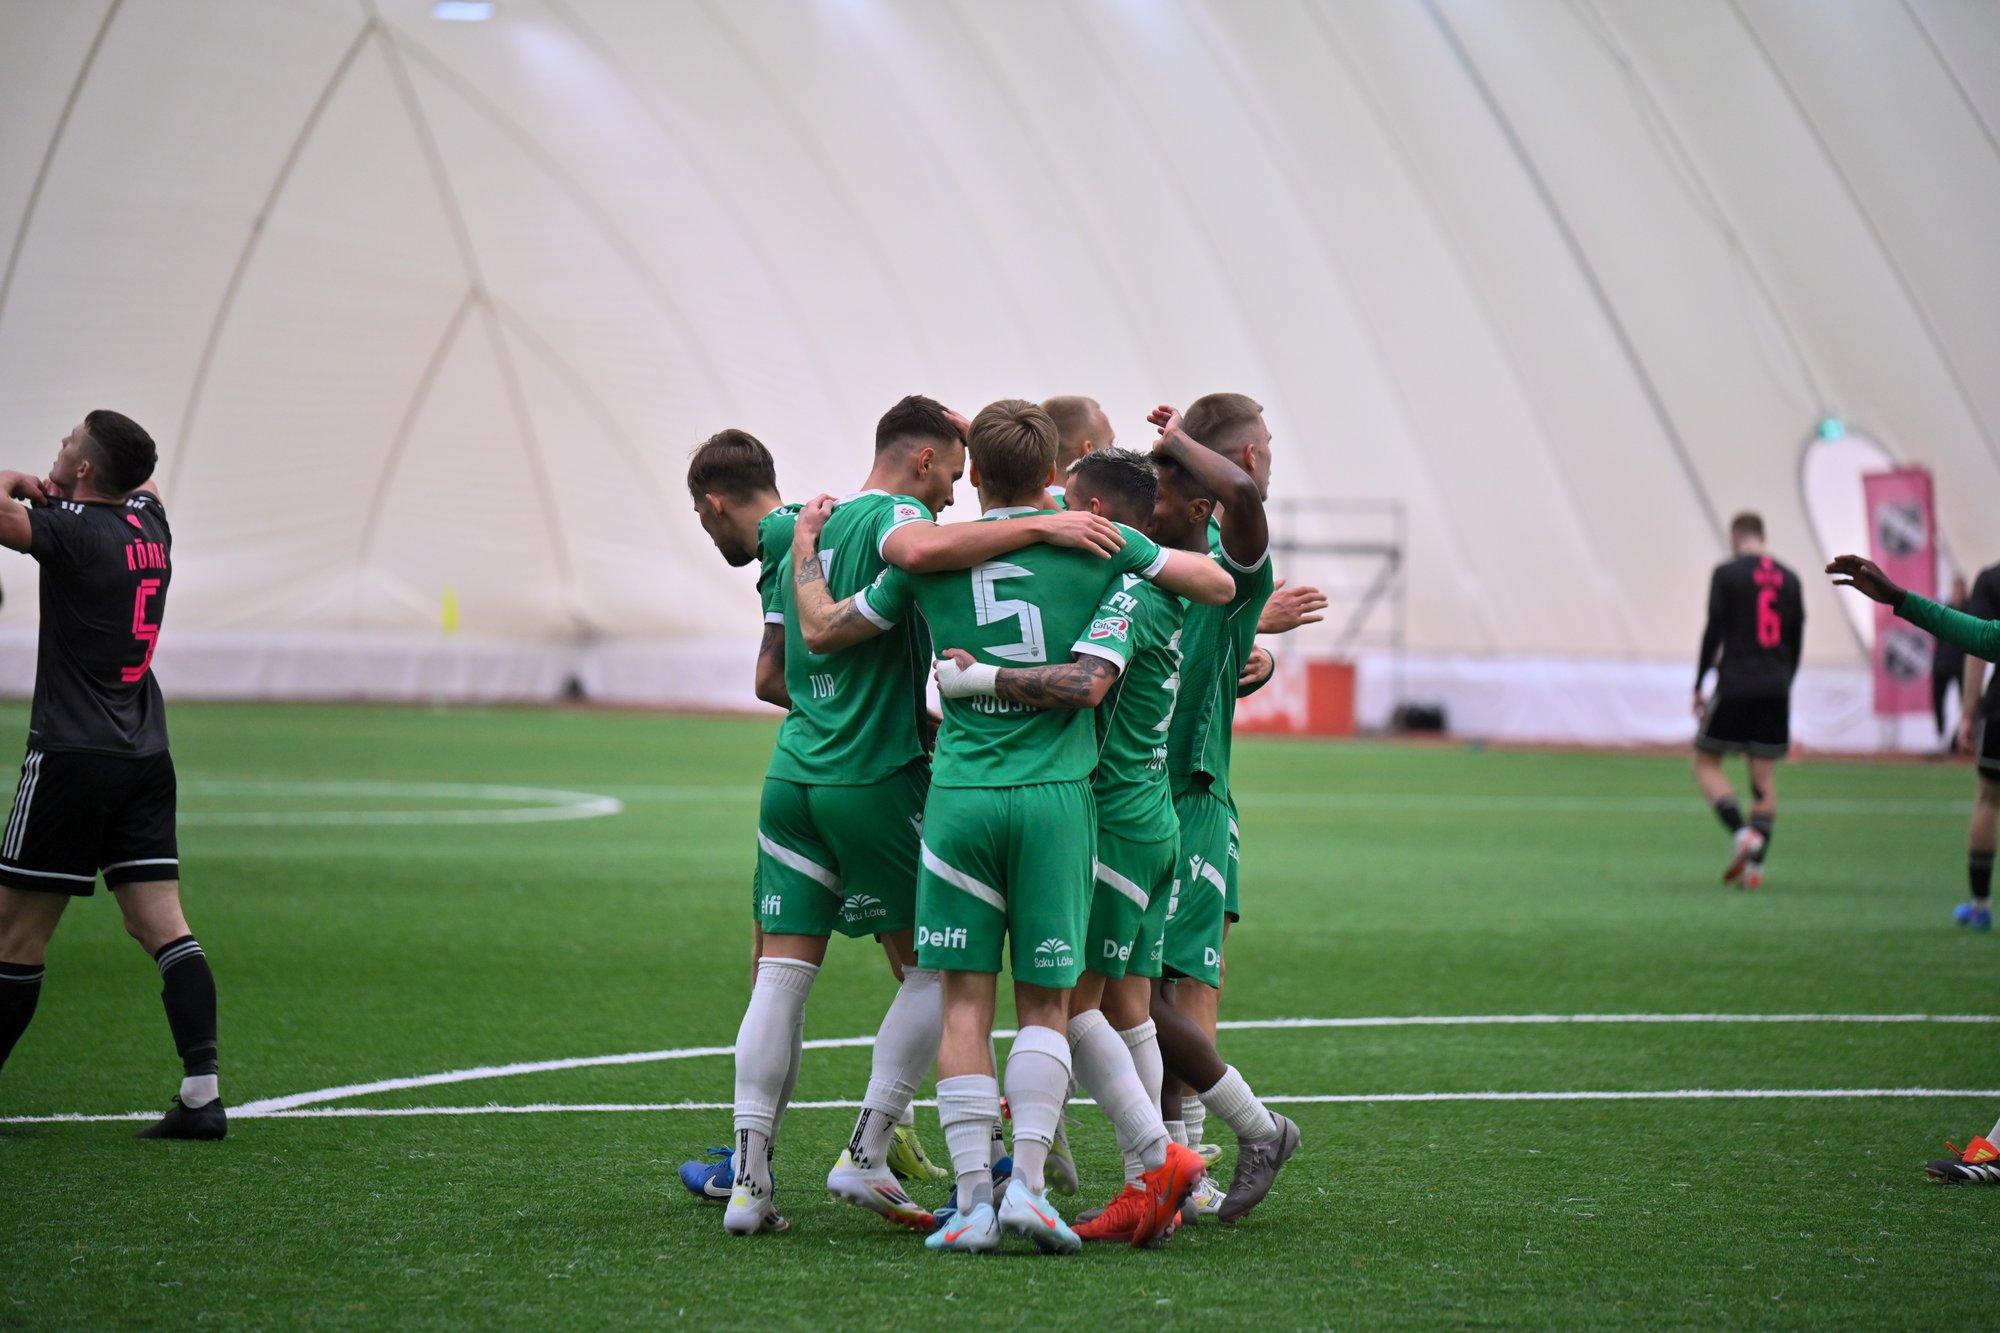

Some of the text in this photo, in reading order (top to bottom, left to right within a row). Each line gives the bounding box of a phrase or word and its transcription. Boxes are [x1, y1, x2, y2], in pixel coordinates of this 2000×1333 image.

[972, 561, 1047, 662] 5
[1108, 591, 1138, 613] FH
[121, 579, 160, 682] 5
[1756, 588, 1781, 648] 6
[809, 674, 835, 699] TUR
[918, 926, 967, 949] Delfi
[1034, 957, 1054, 968] Saku
